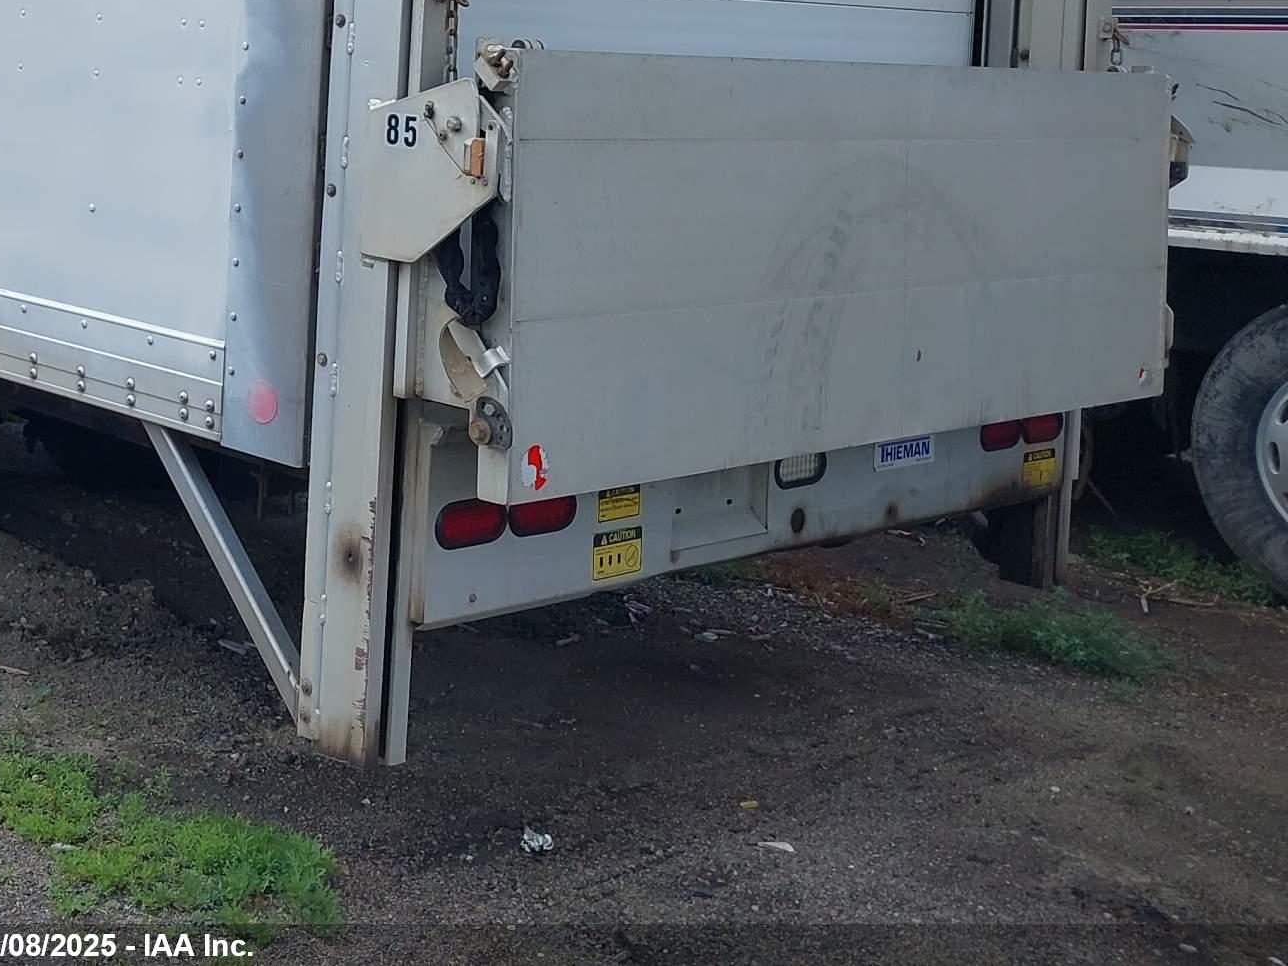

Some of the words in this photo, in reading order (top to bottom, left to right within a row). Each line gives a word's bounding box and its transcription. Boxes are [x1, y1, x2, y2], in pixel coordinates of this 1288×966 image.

[386, 114, 417, 147] 85
[878, 436, 931, 463] THIEMAN
[608, 530, 636, 544] CAUTION
